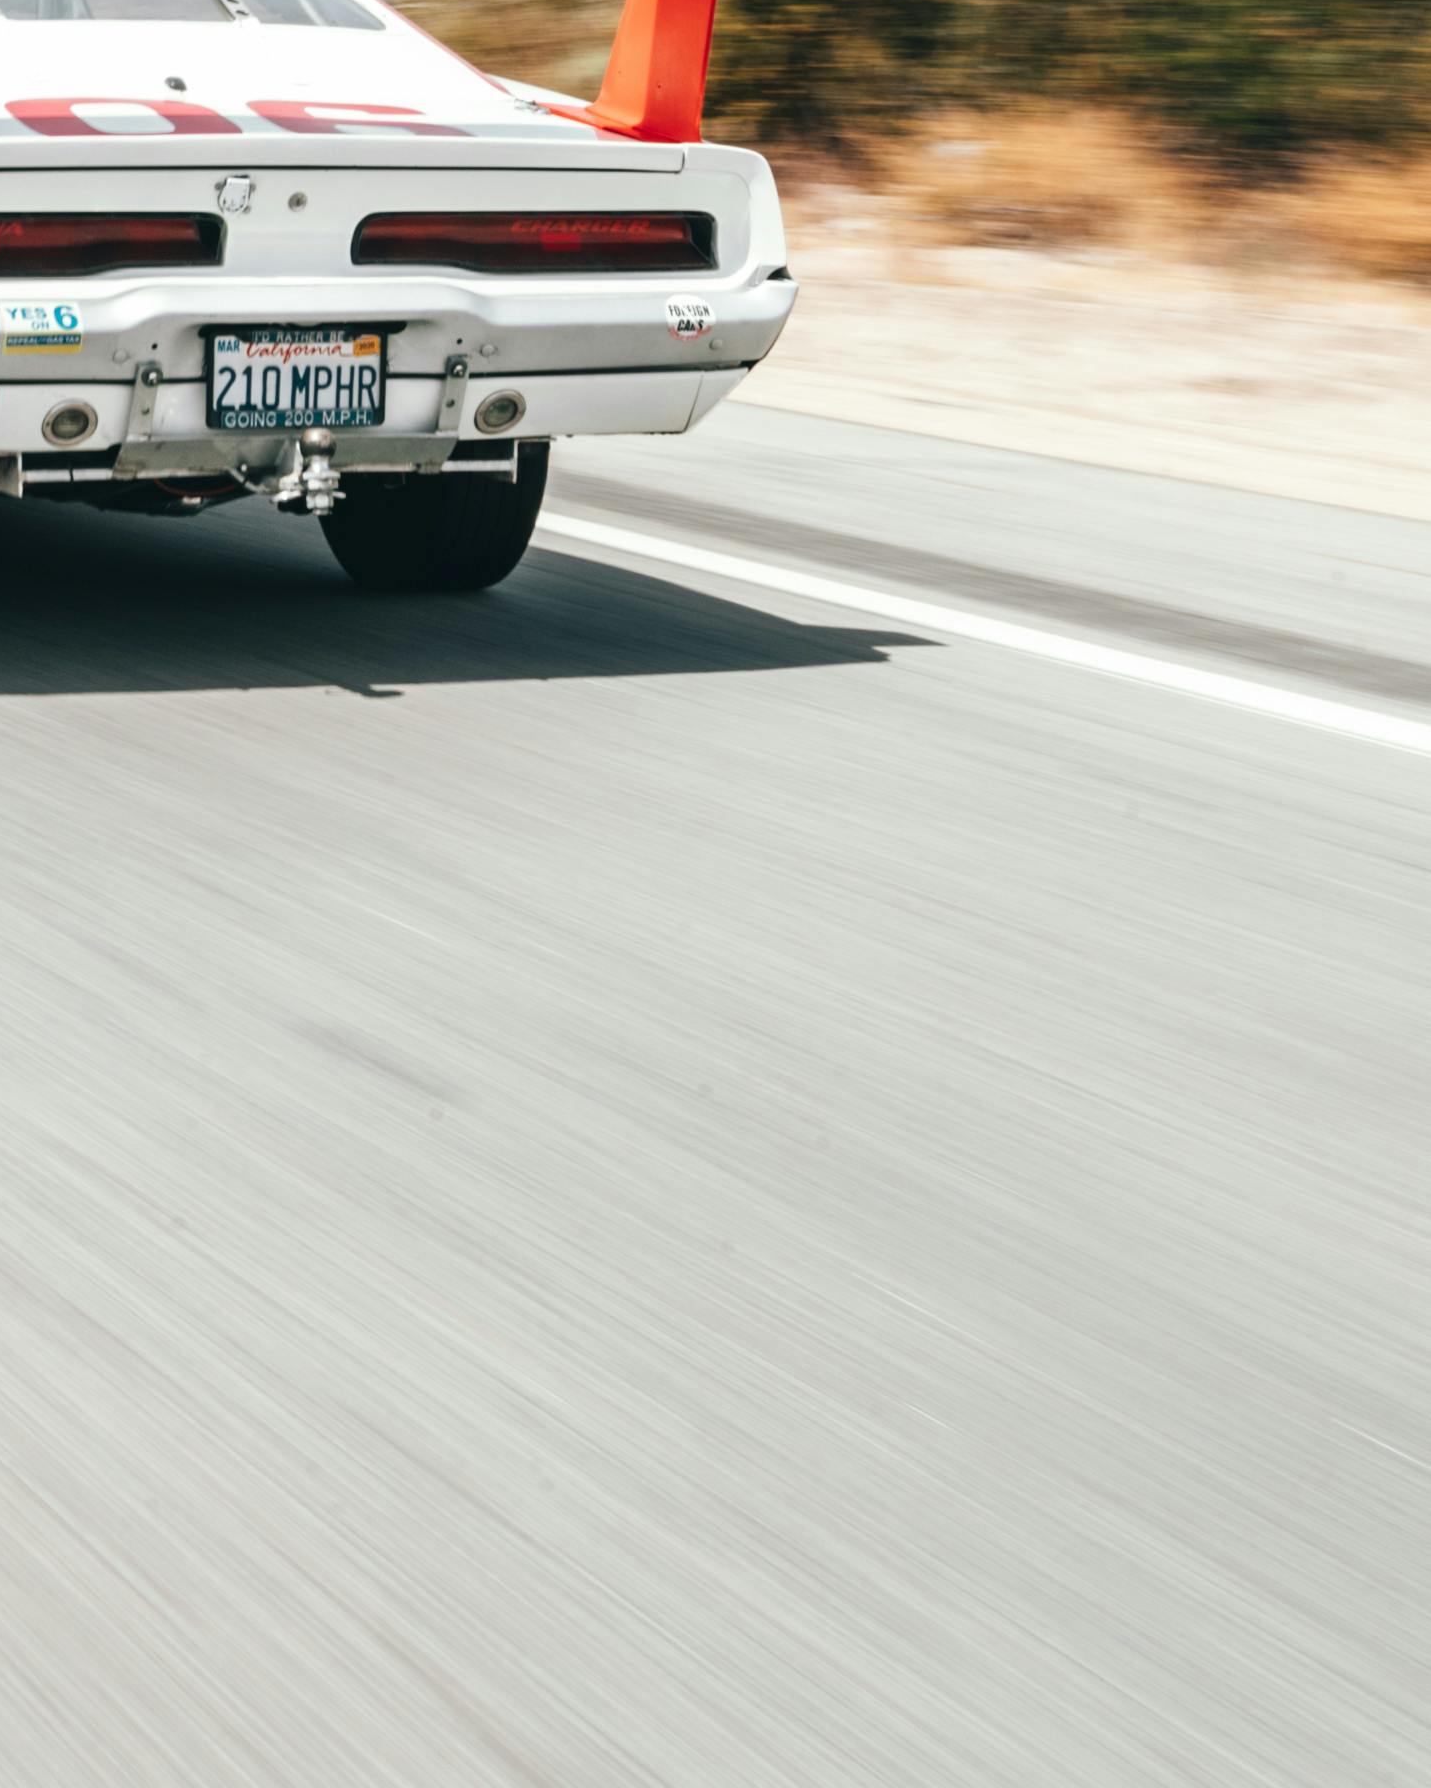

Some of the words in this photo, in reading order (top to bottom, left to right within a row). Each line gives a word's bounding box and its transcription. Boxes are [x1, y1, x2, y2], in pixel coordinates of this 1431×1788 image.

[510, 219, 651, 233] CHARGER
[6, 307, 47, 320] YES
[53, 305, 78, 331] 6
[31, 321, 50, 330] ON
[276, 331, 323, 343] RATHER
[218, 340, 240, 353] MAR
[244, 342, 349, 364] California
[216, 365, 282, 411] 210
[290, 365, 380, 411] MPHR
[224, 412, 277, 428] GOING
[284, 412, 314, 427] 200
[322, 410, 371, 426] M.P.H.
